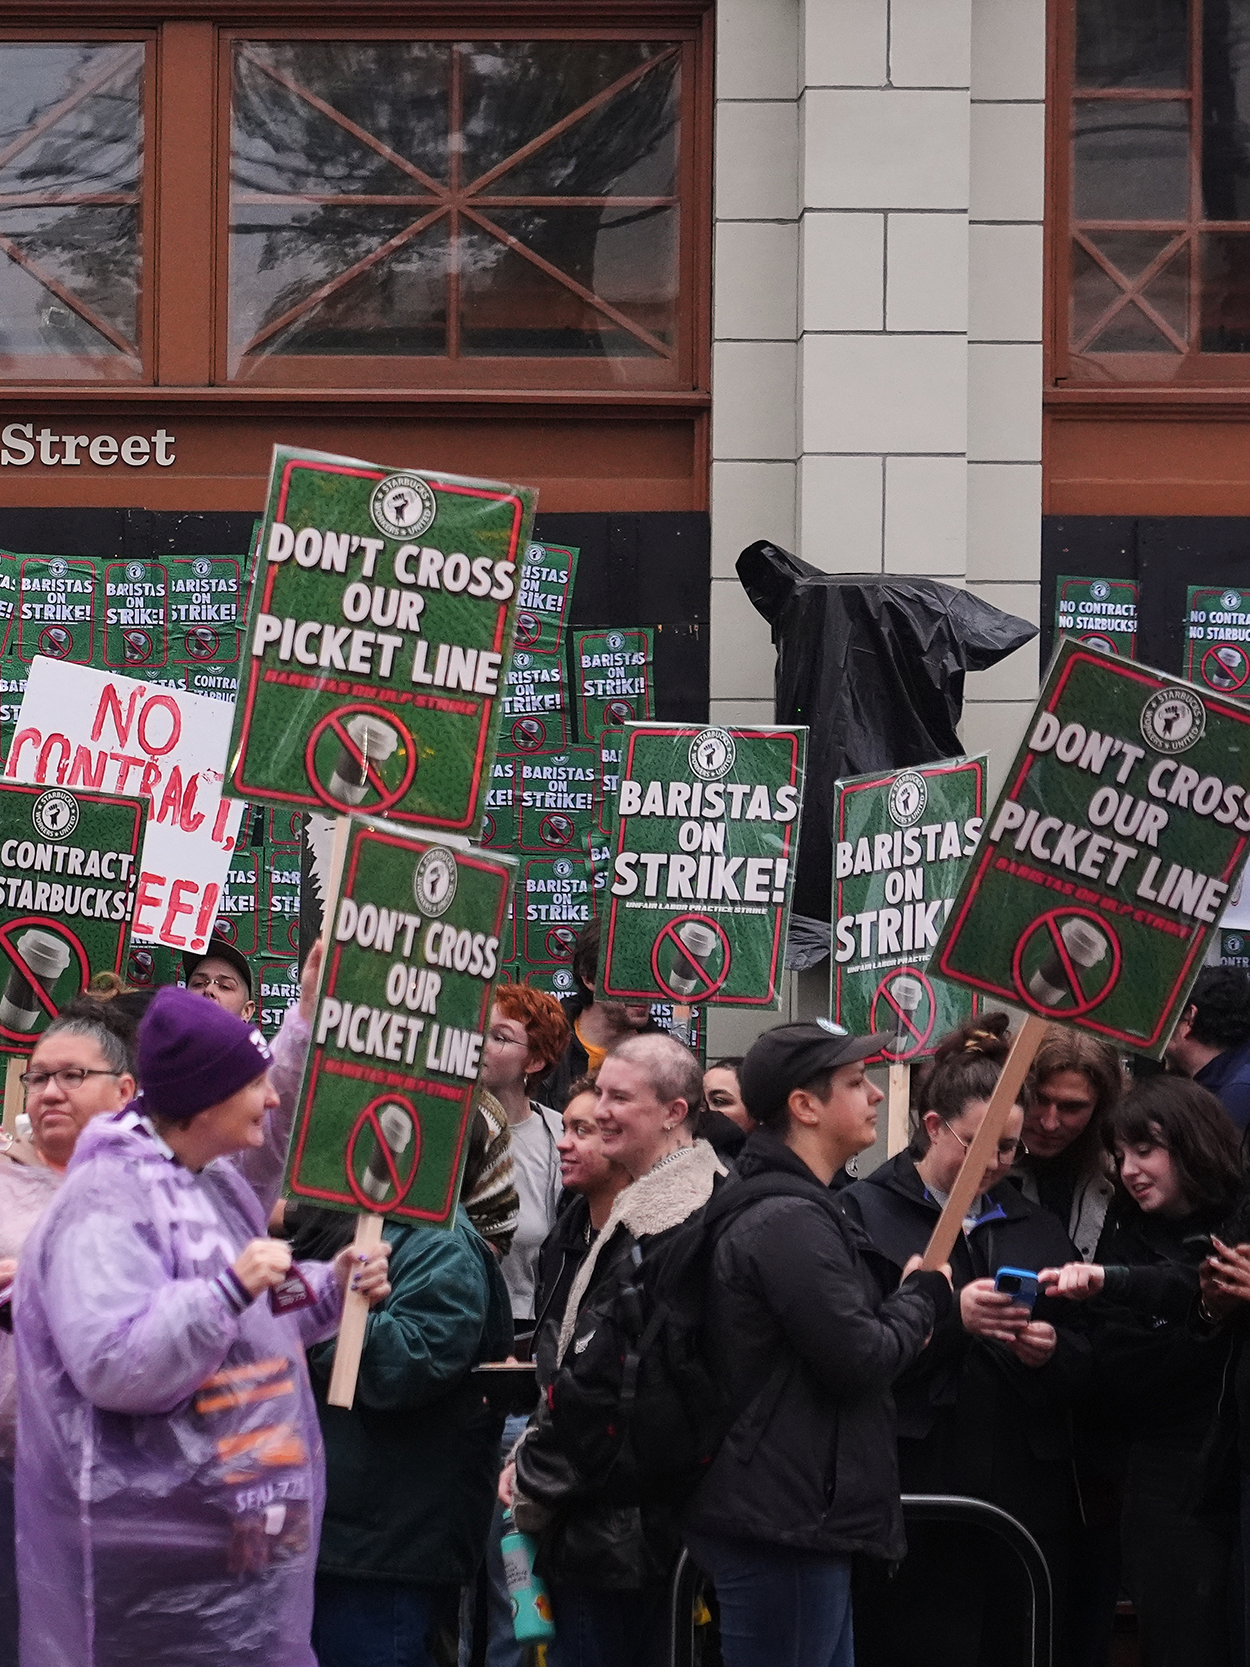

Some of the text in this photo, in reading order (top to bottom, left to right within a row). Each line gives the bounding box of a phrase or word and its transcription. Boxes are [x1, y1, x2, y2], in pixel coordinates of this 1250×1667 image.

[0, 422, 176, 467] Street
[382, 478, 430, 500] STARBUCKS
[267, 522, 516, 601] DON'T CROSS
[21, 577, 93, 593] BARISTAS
[521, 579, 540, 592] ON
[49, 592, 66, 604] ON
[126, 597, 145, 608] ON
[192, 593, 211, 604] ON
[343, 582, 425, 632] OUR
[21, 603, 91, 621] STRIKE!
[1060, 600, 1138, 618] NO CONTRACT,
[1190, 611, 1206, 623] NO
[1058, 616, 1138, 633] NO STARBUCKS!
[1189, 626, 1204, 639] NO
[252, 613, 502, 696] PICKET LINE
[608, 666, 625, 678] ON
[515, 684, 535, 696] ON
[502, 694, 561, 713] TRIKE!
[90, 682, 182, 756] NO
[695, 731, 732, 746] STARBUCKS
[1029, 711, 1146, 784] DON'T
[1171, 727, 1200, 750] UNITED
[522, 766, 595, 782] BARISTAS
[549, 780, 567, 793] ON
[39, 792, 75, 813] STARBUCKS
[522, 792, 593, 810] STRIKE!
[619, 781, 798, 822] BARISTAS
[59, 814, 77, 837] UNITED
[1088, 786, 1169, 848] OUR
[678, 820, 726, 853] ON
[836, 817, 983, 879] BARISTAS
[1, 839, 136, 888] CONTRACT,
[989, 800, 1229, 924] PICKET LINE
[526, 879, 587, 893] BARISTA
[610, 852, 789, 903] STRIKE!
[885, 867, 923, 904] ON
[552, 893, 571, 905] ON
[625, 901, 768, 915] UNFAIR LABOR PRACTICE STRIKE
[336, 898, 499, 980] DON'T CROSS
[835, 898, 955, 963] STRIK
[897, 954, 931, 966] PRACTIC
[386, 963, 442, 1016] OUR
[316, 998, 424, 1067] PICKET
[426, 1023, 484, 1081] LINE
